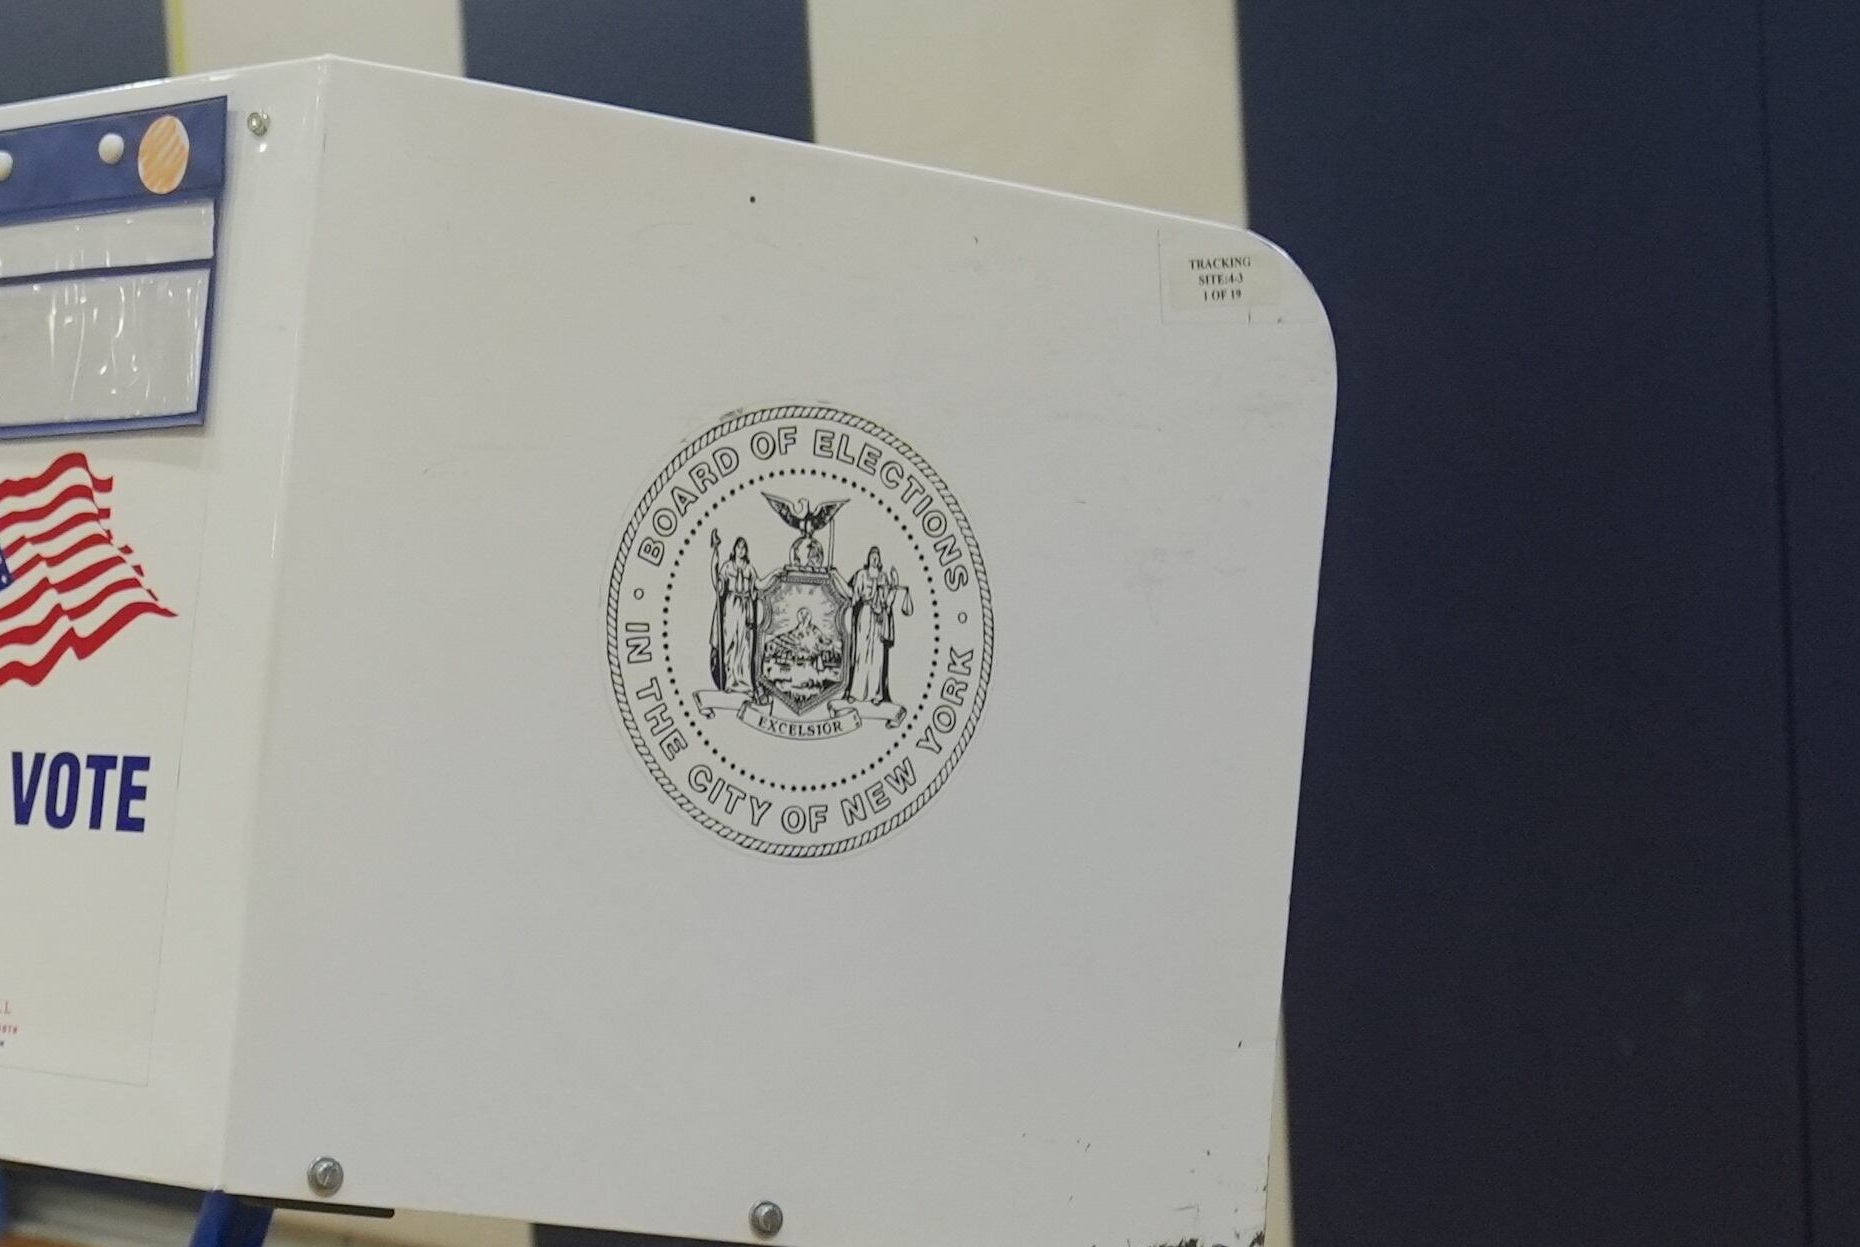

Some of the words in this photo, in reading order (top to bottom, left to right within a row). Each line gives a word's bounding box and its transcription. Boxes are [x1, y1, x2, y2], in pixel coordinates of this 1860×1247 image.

[1189, 256, 1252, 271] TRACKING
[1204, 291, 1208, 302] 1
[1212, 290, 1227, 301] OF
[1231, 288, 1242, 300] 19
[639, 446, 739, 566] BOARD
[751, 426, 797, 460] OF
[813, 430, 969, 592] ELECTIONS
[626, 622, 653, 664] IN
[636, 678, 688, 761] THE
[758, 716, 843, 737] EXCELSIOR
[916, 647, 974, 756] YORK
[12, 751, 151, 832] VOTE
[688, 765, 772, 827] CITY
[782, 806, 828, 833] OF
[841, 759, 916, 827] NEW
